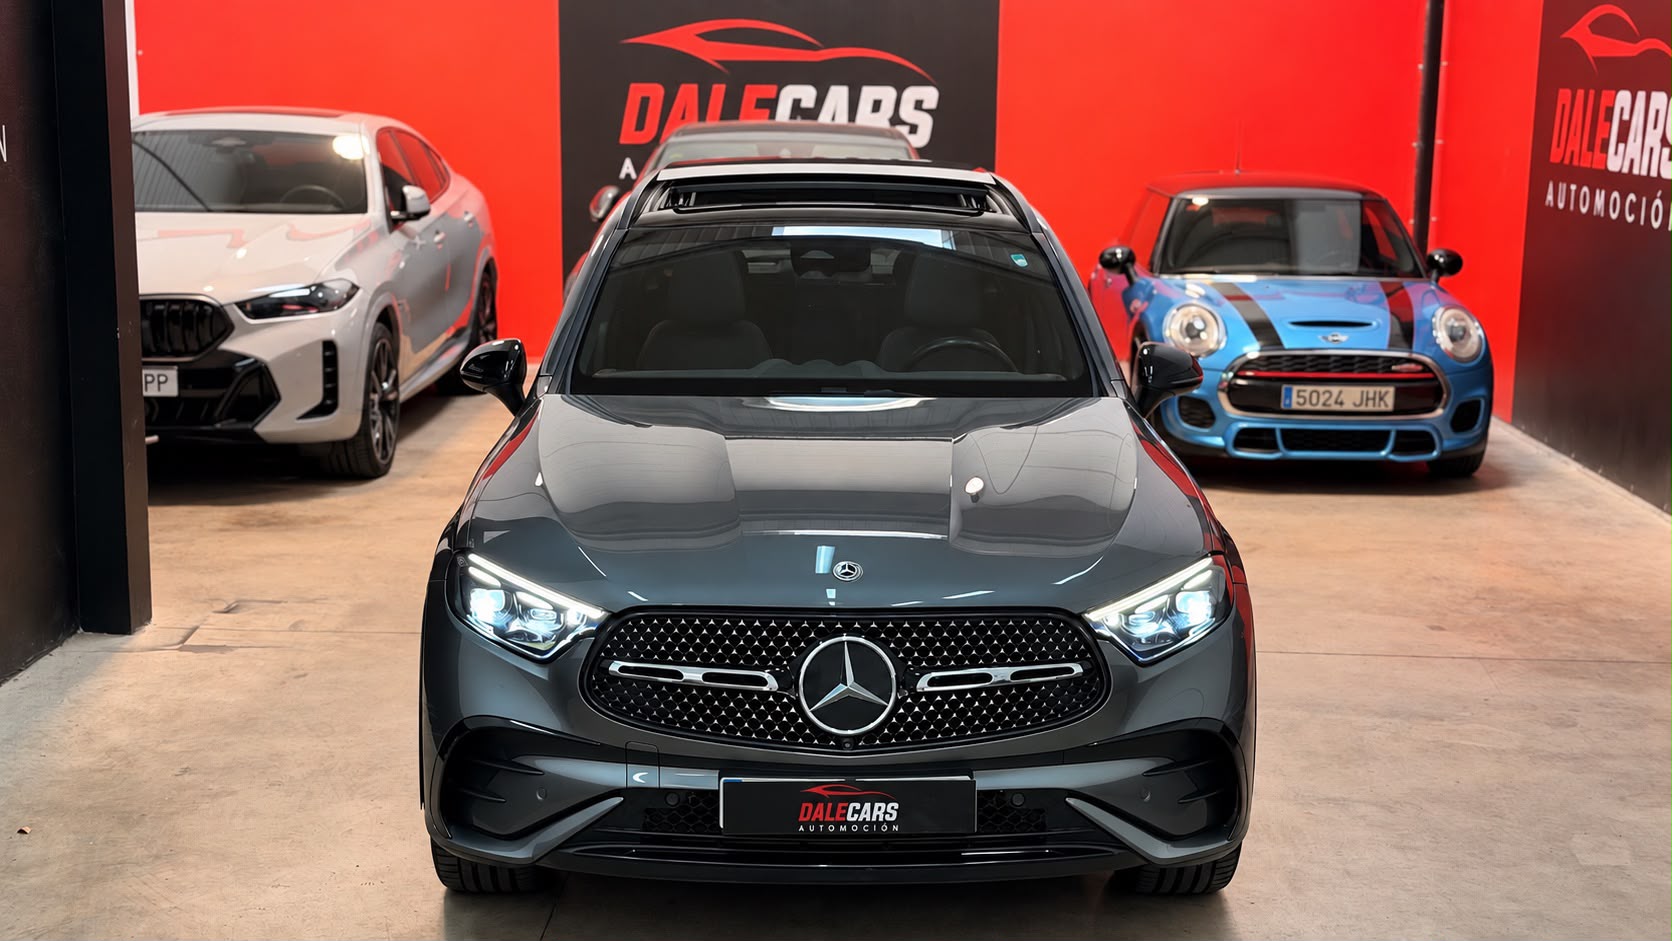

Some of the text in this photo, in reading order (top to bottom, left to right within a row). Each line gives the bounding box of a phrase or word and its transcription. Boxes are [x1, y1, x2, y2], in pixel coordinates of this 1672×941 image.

[619, 83, 939, 148] DALECARS
[1545, 180, 1672, 231] AUTOMOCIÓ
[1296, 389, 1390, 408] 5024 JHK
[799, 802, 899, 821] DALECARS
[798, 823, 899, 832] AUTOMOCIÓN
